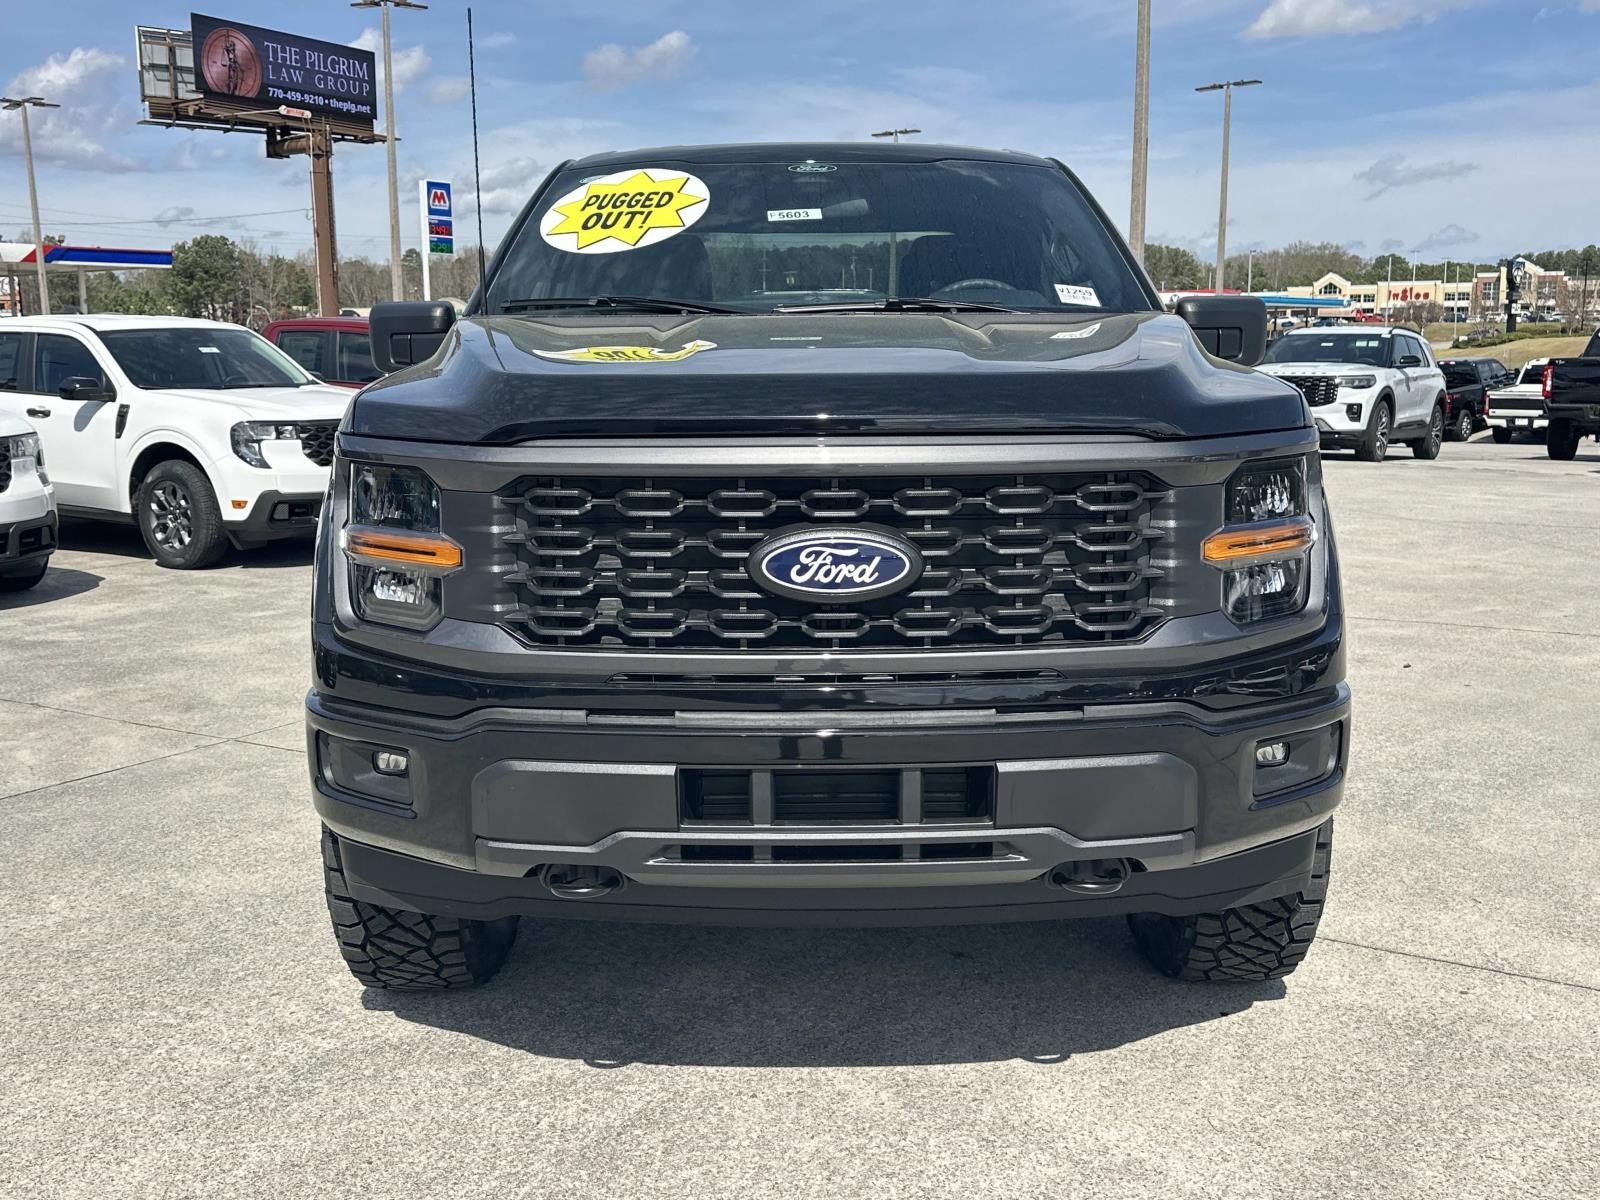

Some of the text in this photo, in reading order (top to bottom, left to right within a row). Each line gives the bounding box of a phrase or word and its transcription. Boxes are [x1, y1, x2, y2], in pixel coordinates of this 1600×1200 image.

[264, 41, 369, 80] THE PILGRIM
[268, 65, 370, 96] LAW GROUP
[268, 87, 324, 105] 770-459-9210
[580, 192, 674, 212] PUGGED
[581, 211, 653, 231] OUT!
[790, 546, 882, 583] Ford
